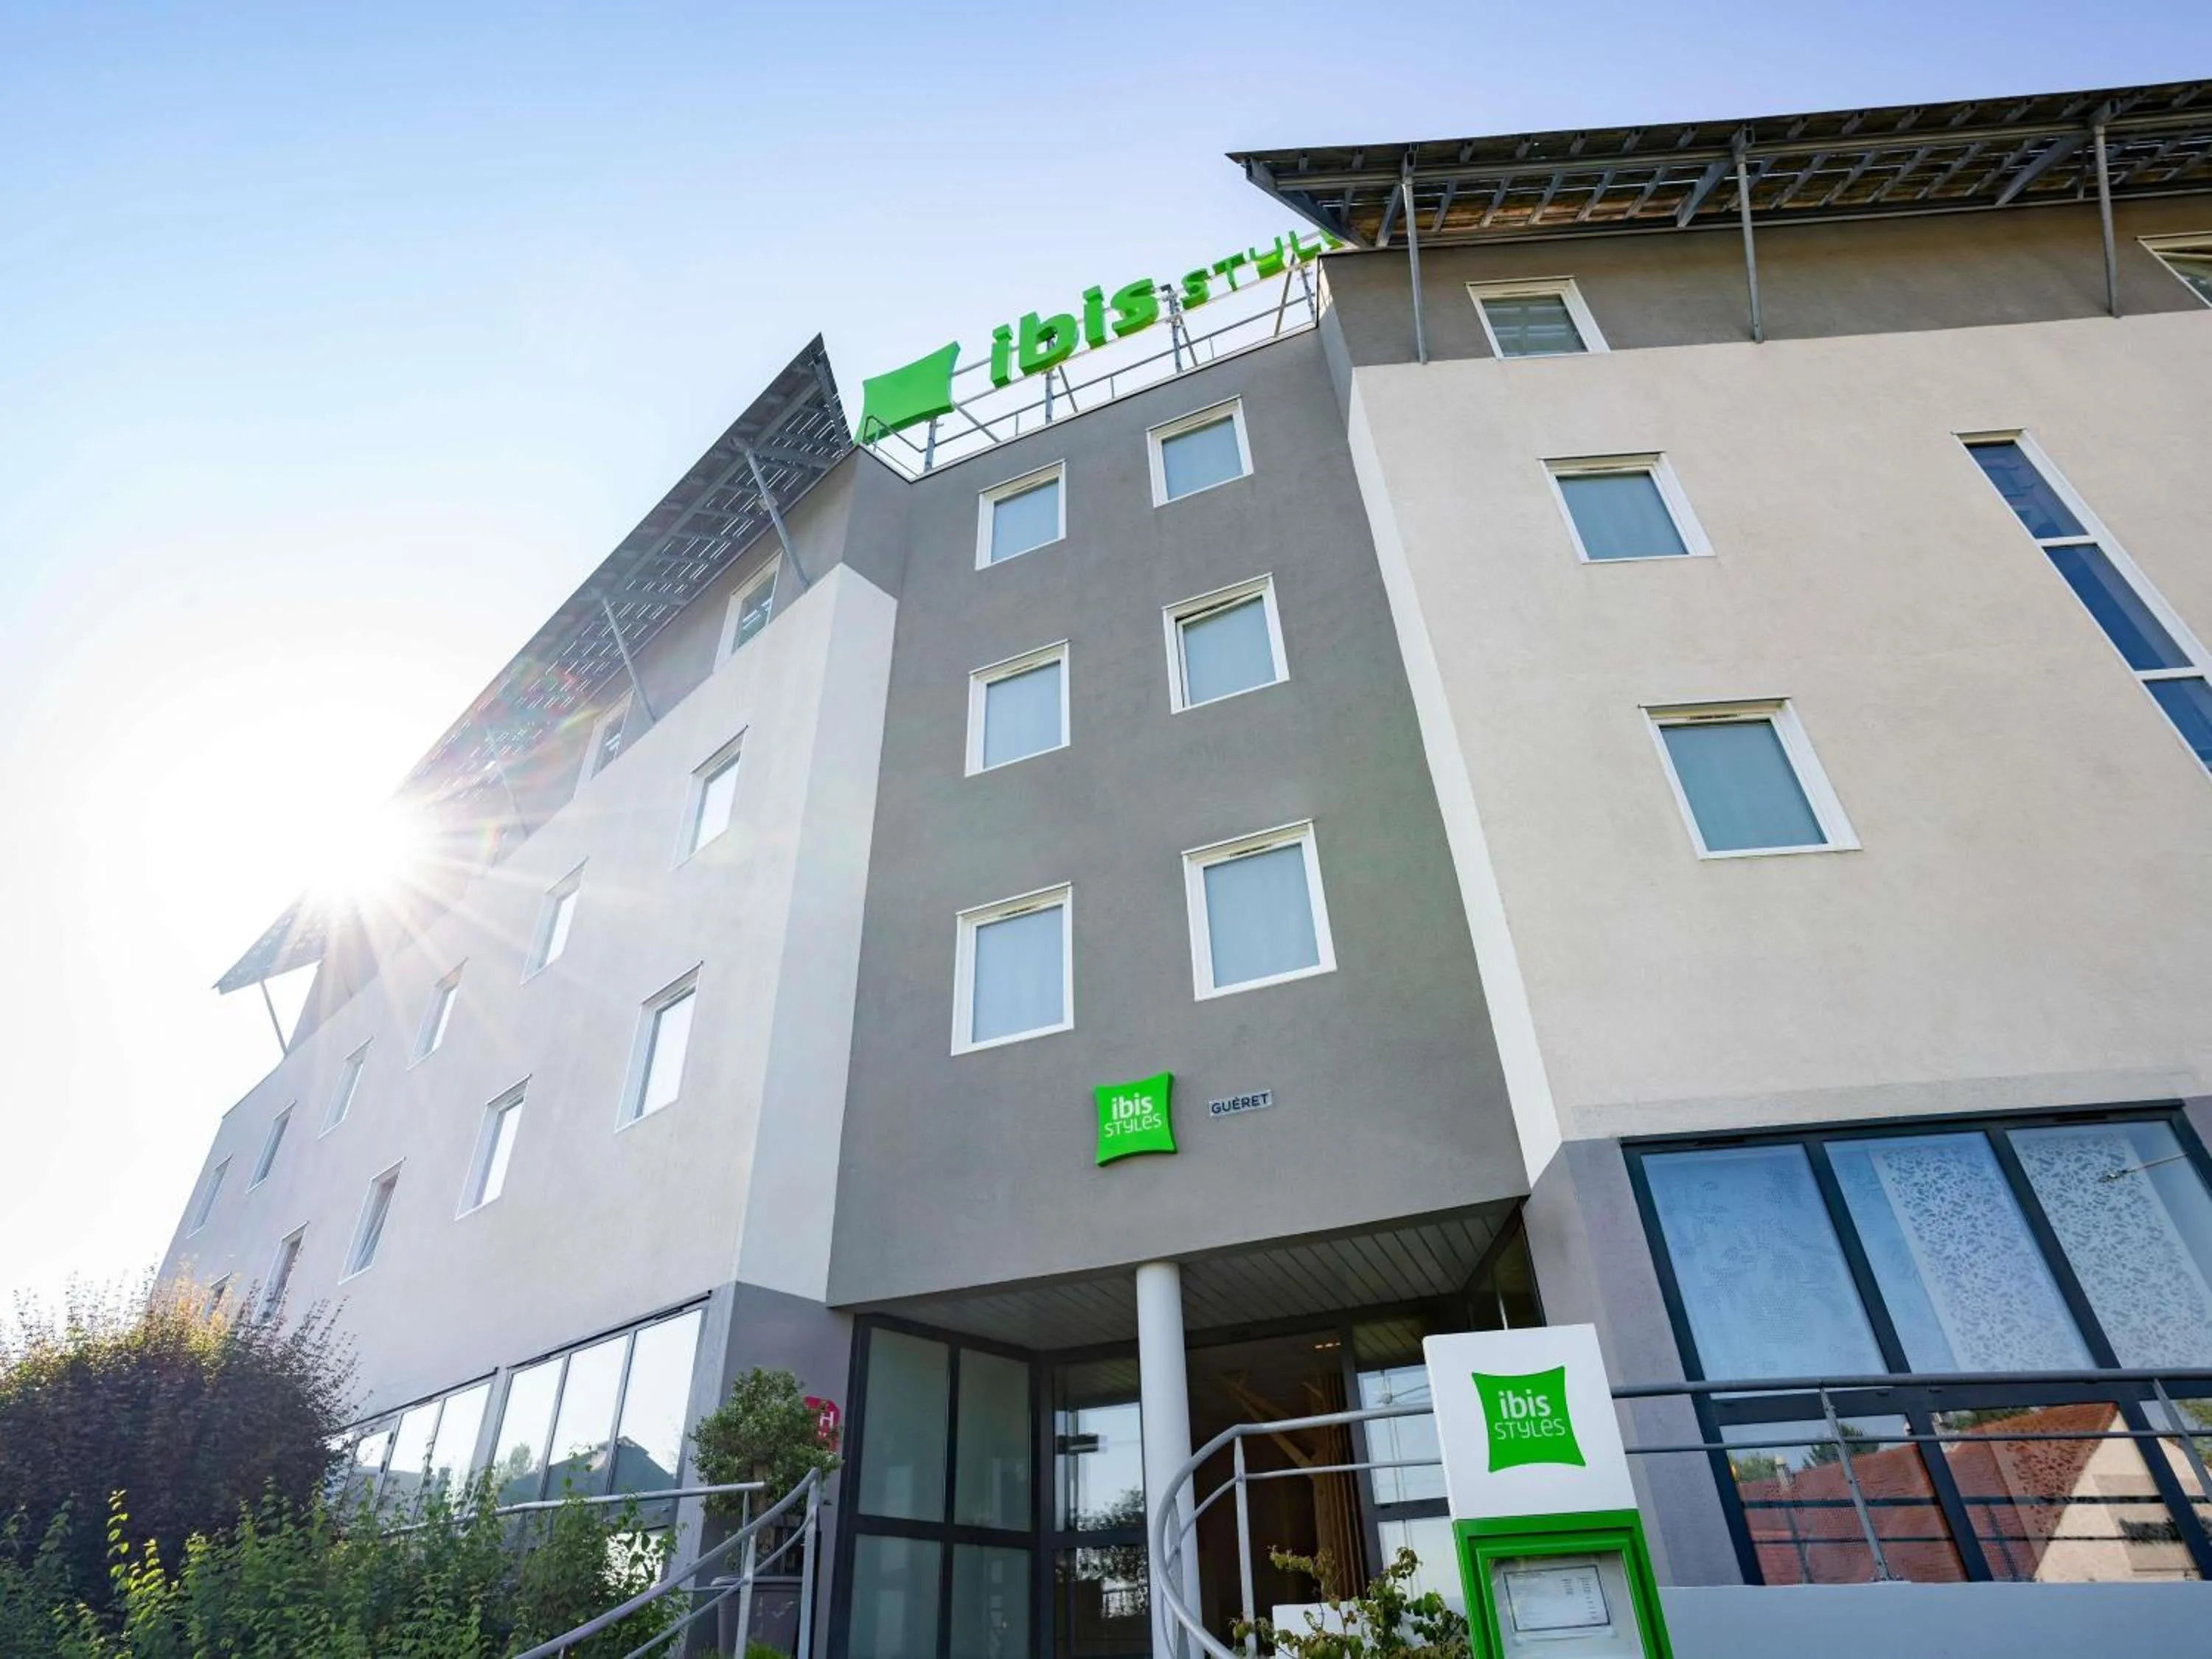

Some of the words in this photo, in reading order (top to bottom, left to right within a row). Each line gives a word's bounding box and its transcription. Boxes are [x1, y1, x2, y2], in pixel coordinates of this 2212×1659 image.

[990, 278, 1160, 389] ibis
[1180, 229, 1344, 302] STYL
[1111, 1092, 1153, 1120] ibis
[1211, 1093, 1269, 1115] GUÉRET
[1498, 1388, 1551, 1419] ibis
